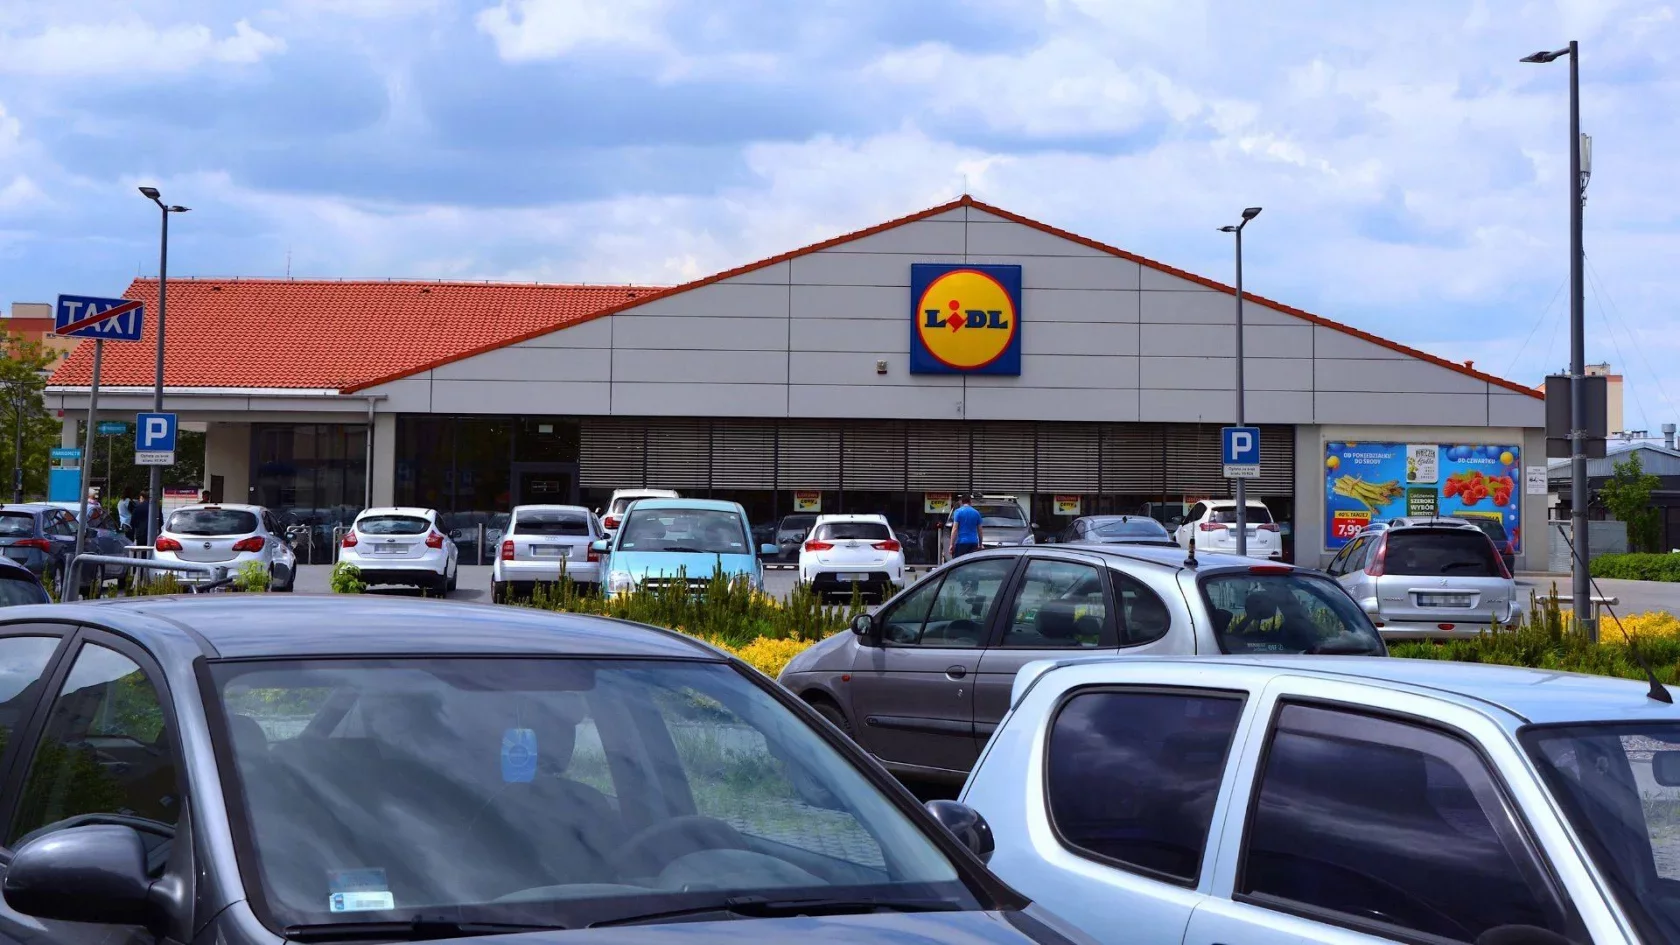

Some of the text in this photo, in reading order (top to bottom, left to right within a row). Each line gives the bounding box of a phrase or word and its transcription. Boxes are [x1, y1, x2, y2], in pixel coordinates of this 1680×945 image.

[62, 300, 136, 335] TAXI
[145, 417, 167, 446] P
[1231, 431, 1252, 460] P
[1338, 524, 1361, 537] 7,99
